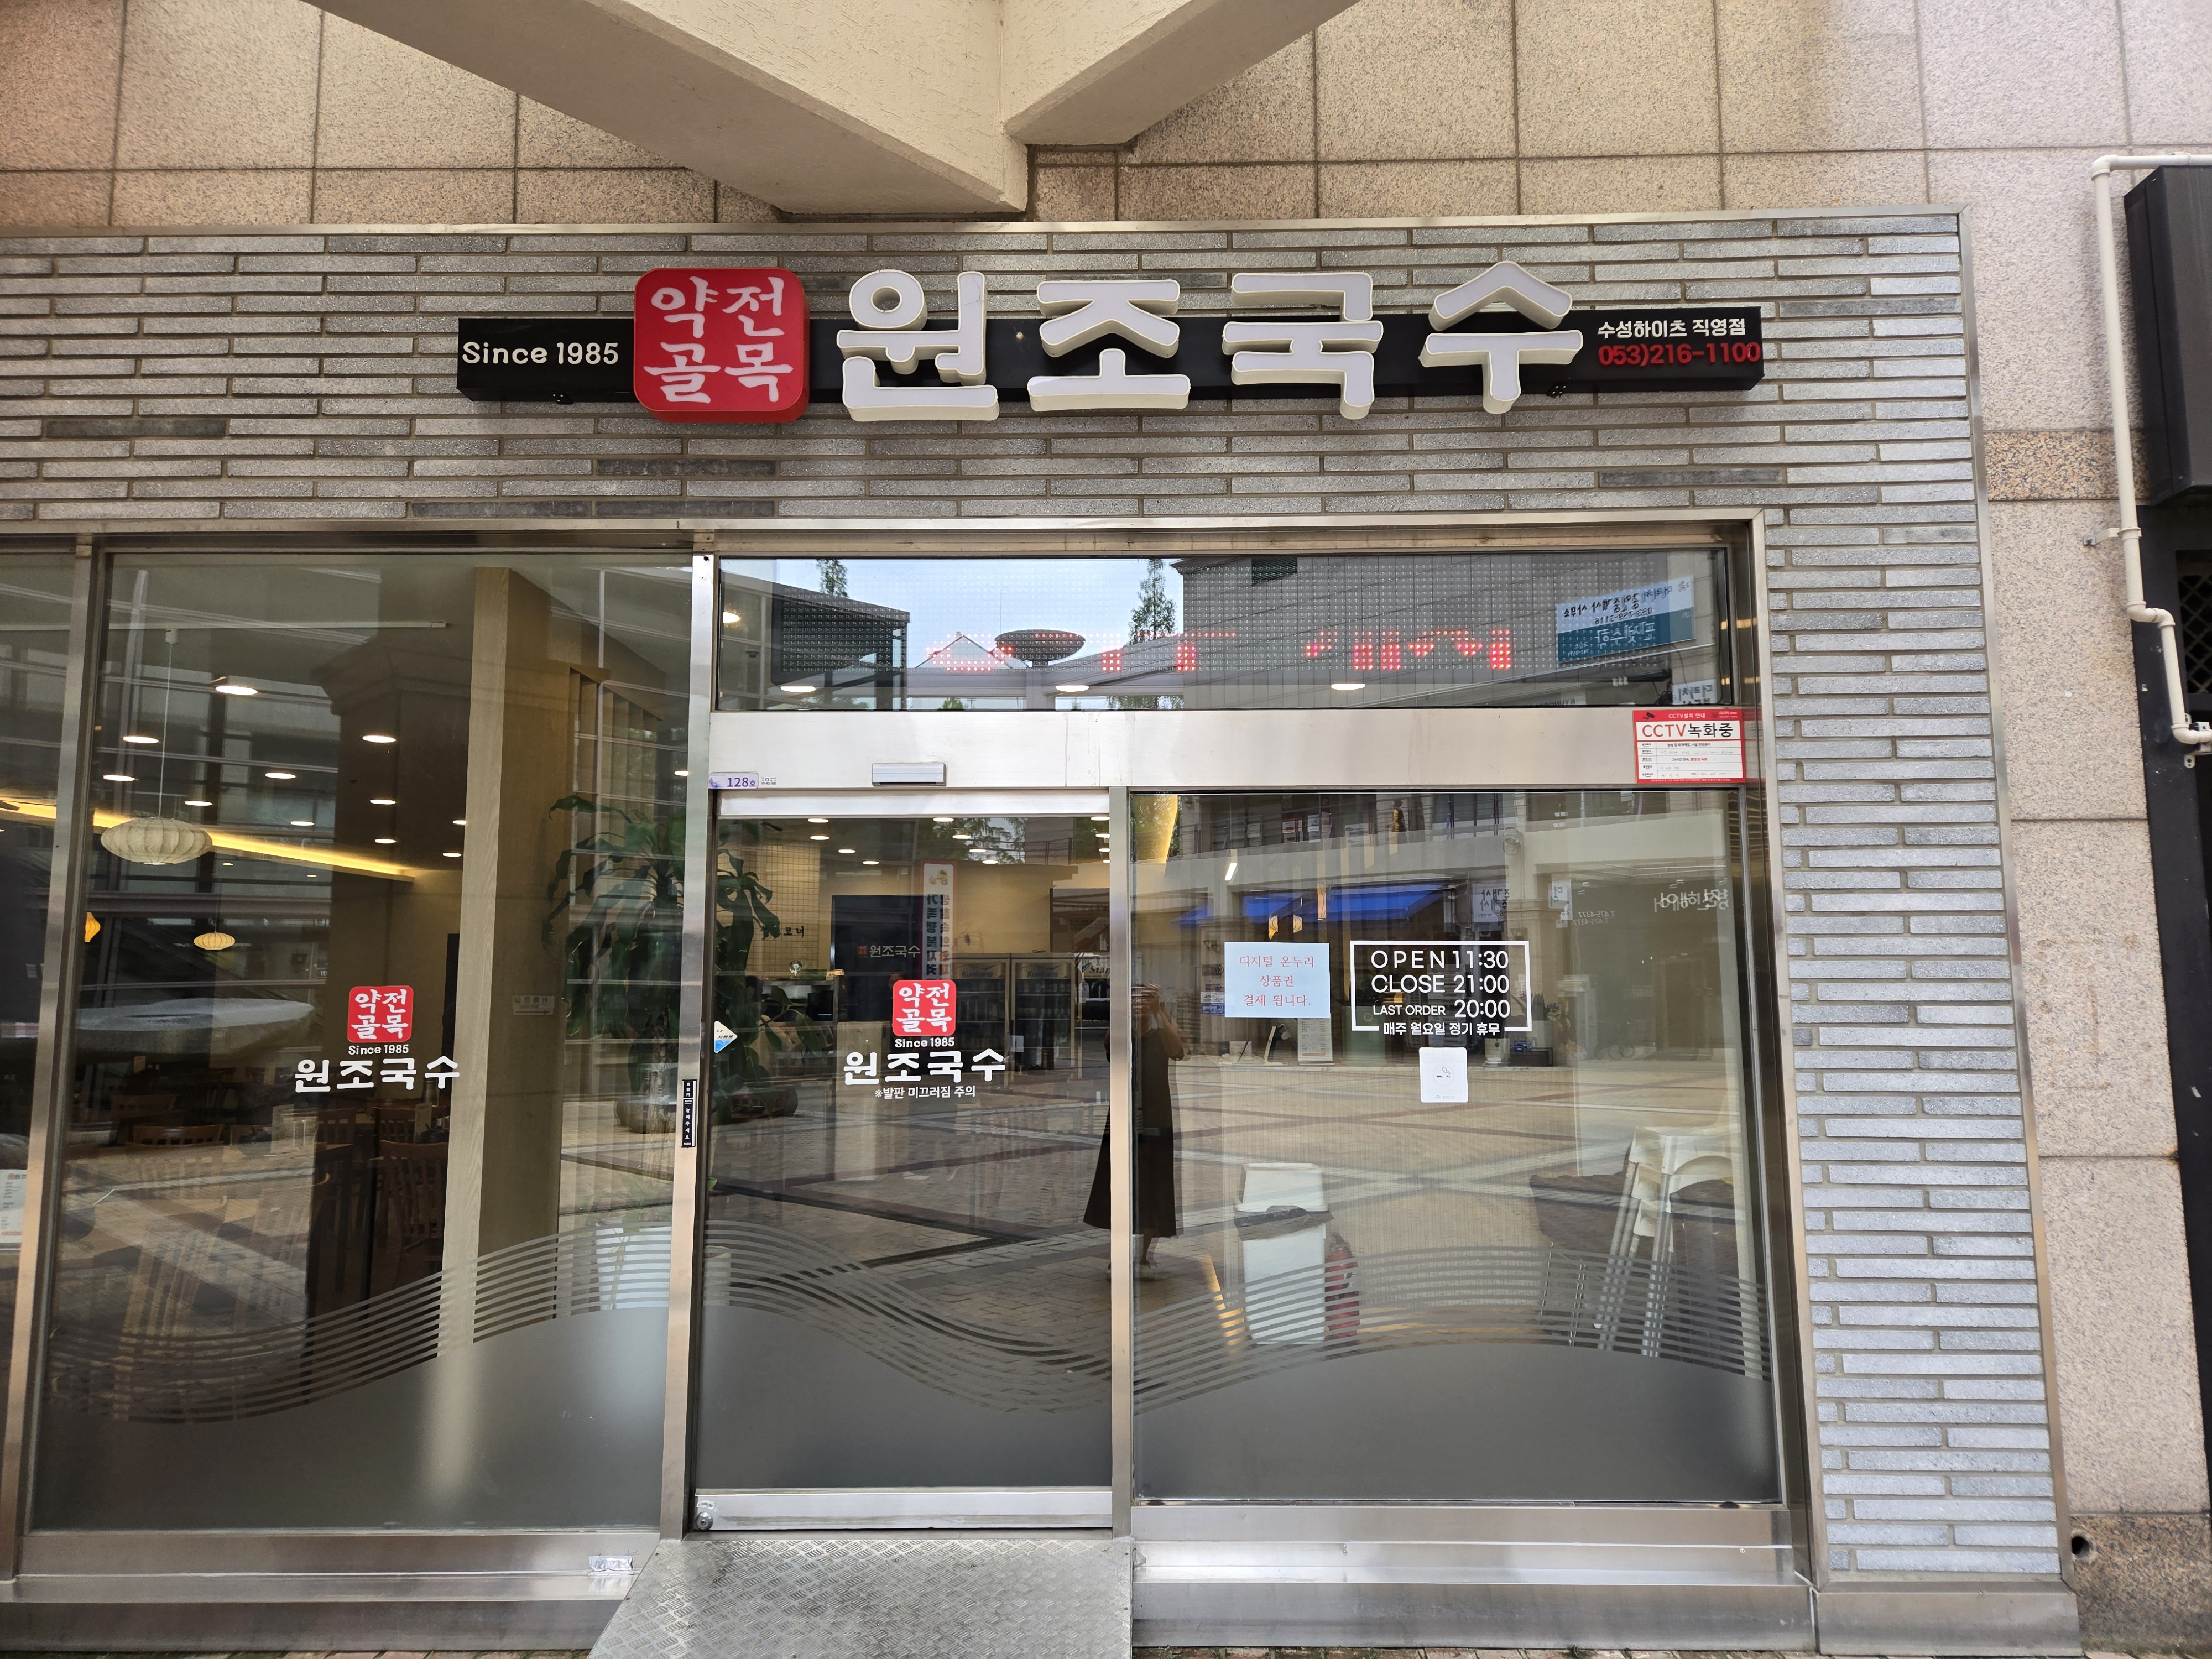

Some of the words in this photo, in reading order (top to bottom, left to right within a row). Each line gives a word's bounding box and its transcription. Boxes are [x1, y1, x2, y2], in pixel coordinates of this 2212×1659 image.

[651, 277, 785, 338] 약전
[1598, 319, 1687, 339] 수성하이츠
[1692, 317, 1746, 337] 직영점
[837, 260, 1583, 421] 원조국수
[462, 342, 547, 364] Since
[556, 342, 619, 364] 1985
[1598, 342, 1761, 366] 053)216-1100
[644, 342, 794, 403] 골목
[1642, 723, 1734, 738] CCTV녹화중
[727, 777, 757, 787] 128호
[869, 945, 921, 958] 원조국수
[1371, 950, 1446, 969] OPEN
[1451, 950, 1509, 969] 11:30
[1239, 956, 1273, 968] 디지털
[1280, 956, 1314, 968] 온누리
[1260, 975, 1294, 988] 상품권
[1371, 975, 1446, 994] CLOSE
[1453, 975, 1510, 994] 21:00
[354, 989, 406, 1013] 약전
[899, 982, 950, 1008] 약전
[1244, 995, 1266, 1006] 결제
[1272, 995, 1311, 1006] 됩니다.
[1373, 1005, 1403, 1016] LAST
[1405, 1005, 1446, 1016] ORDER
[1454, 999, 1511, 1019] 20:00
[351, 1014, 409, 1040] 골목
[896, 1008, 953, 1033] 골목
[1383, 1022, 1407, 1036] 매주
[1410, 1022, 1446, 1036] 월요일
[1449, 1022, 1473, 1036] 정기
[1476, 1022, 1500, 1036] 휴무
[348, 1045, 381, 1055] Since
[384, 1044, 409, 1054] 1985
[894, 1037, 928, 1048] Since
[930, 1036, 955, 1047] 1985
[294, 1056, 460, 1093] 원조국수
[843, 1048, 1006, 1086] 원조국수
[908, 1086, 951, 1099] 미끄러짐
[953, 1085, 975, 1098] 주의
